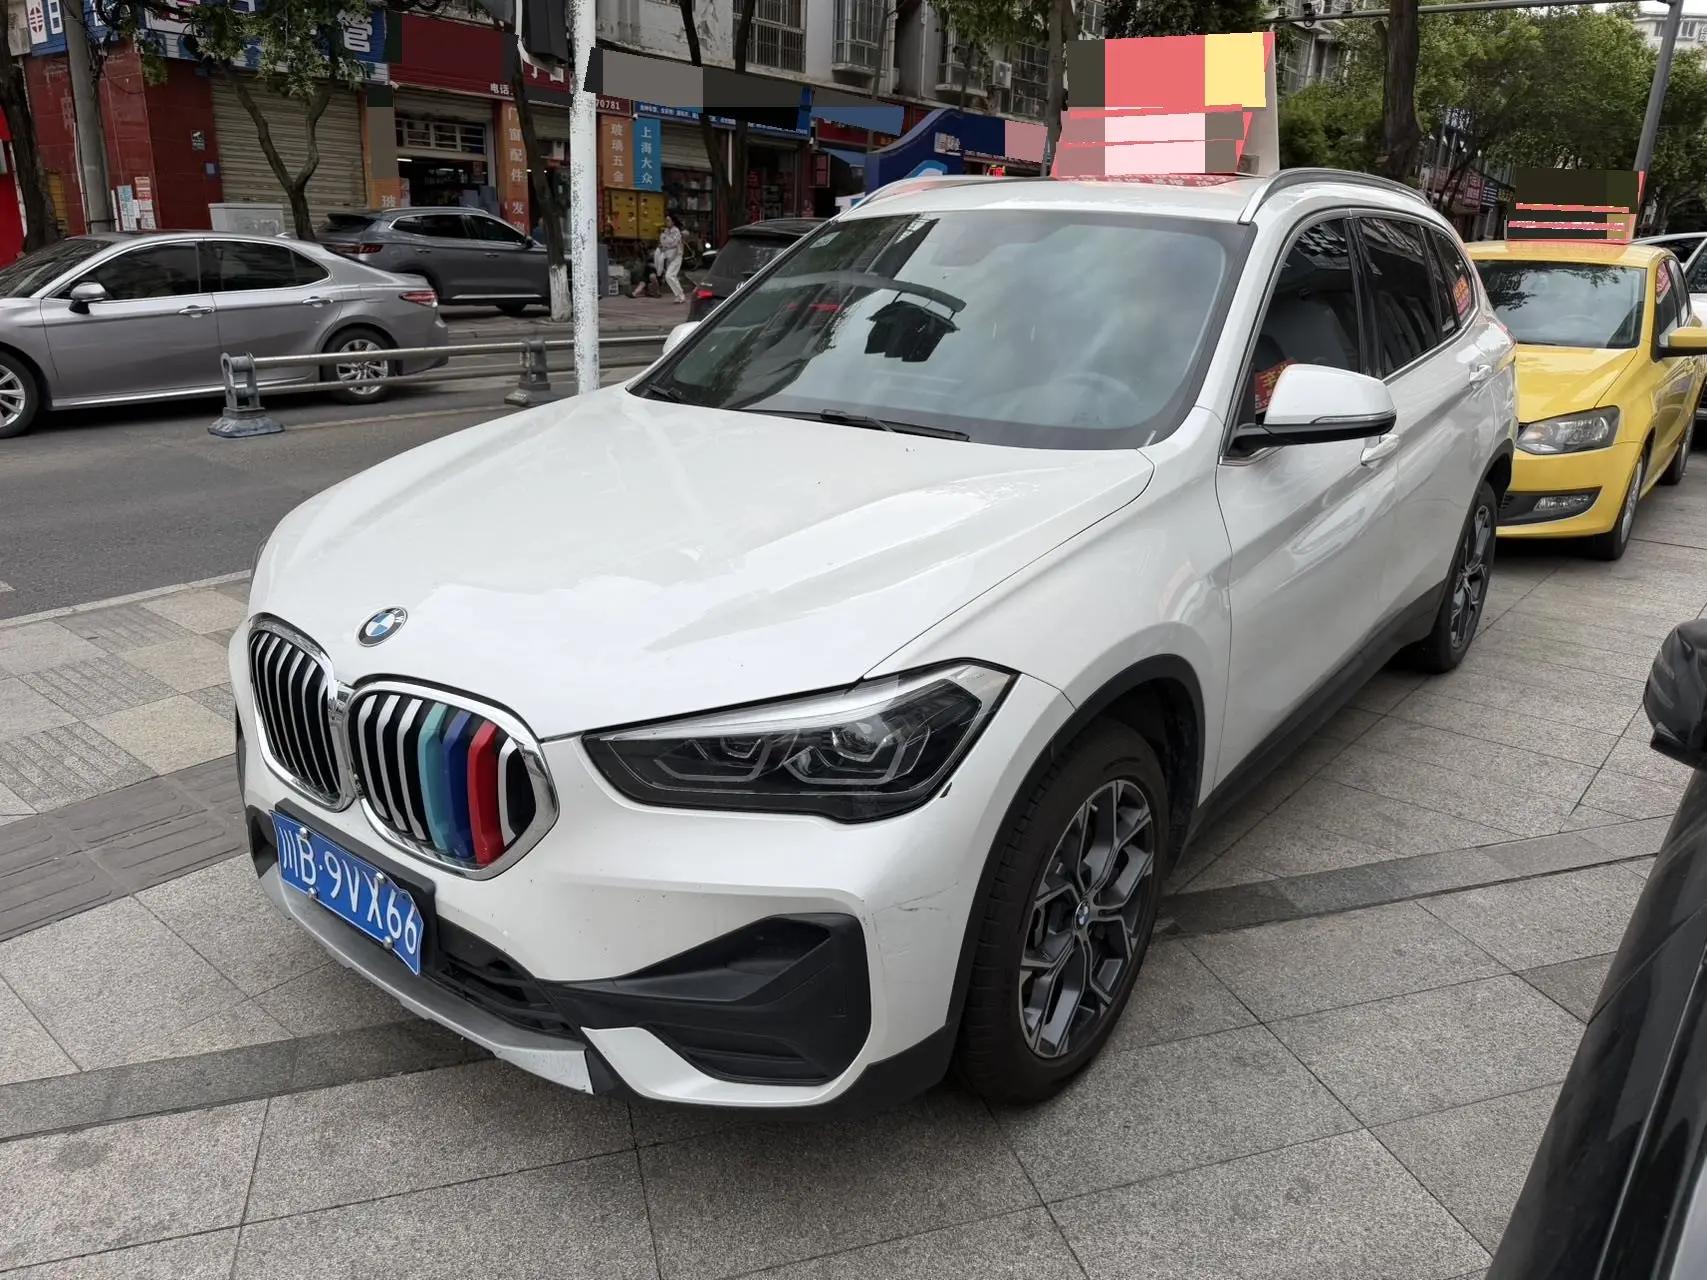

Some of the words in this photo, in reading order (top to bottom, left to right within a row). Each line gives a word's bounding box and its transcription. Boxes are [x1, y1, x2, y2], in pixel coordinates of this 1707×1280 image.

[611, 123, 624, 182] 玻璃五金
[641, 126, 653, 184] 上海大众
